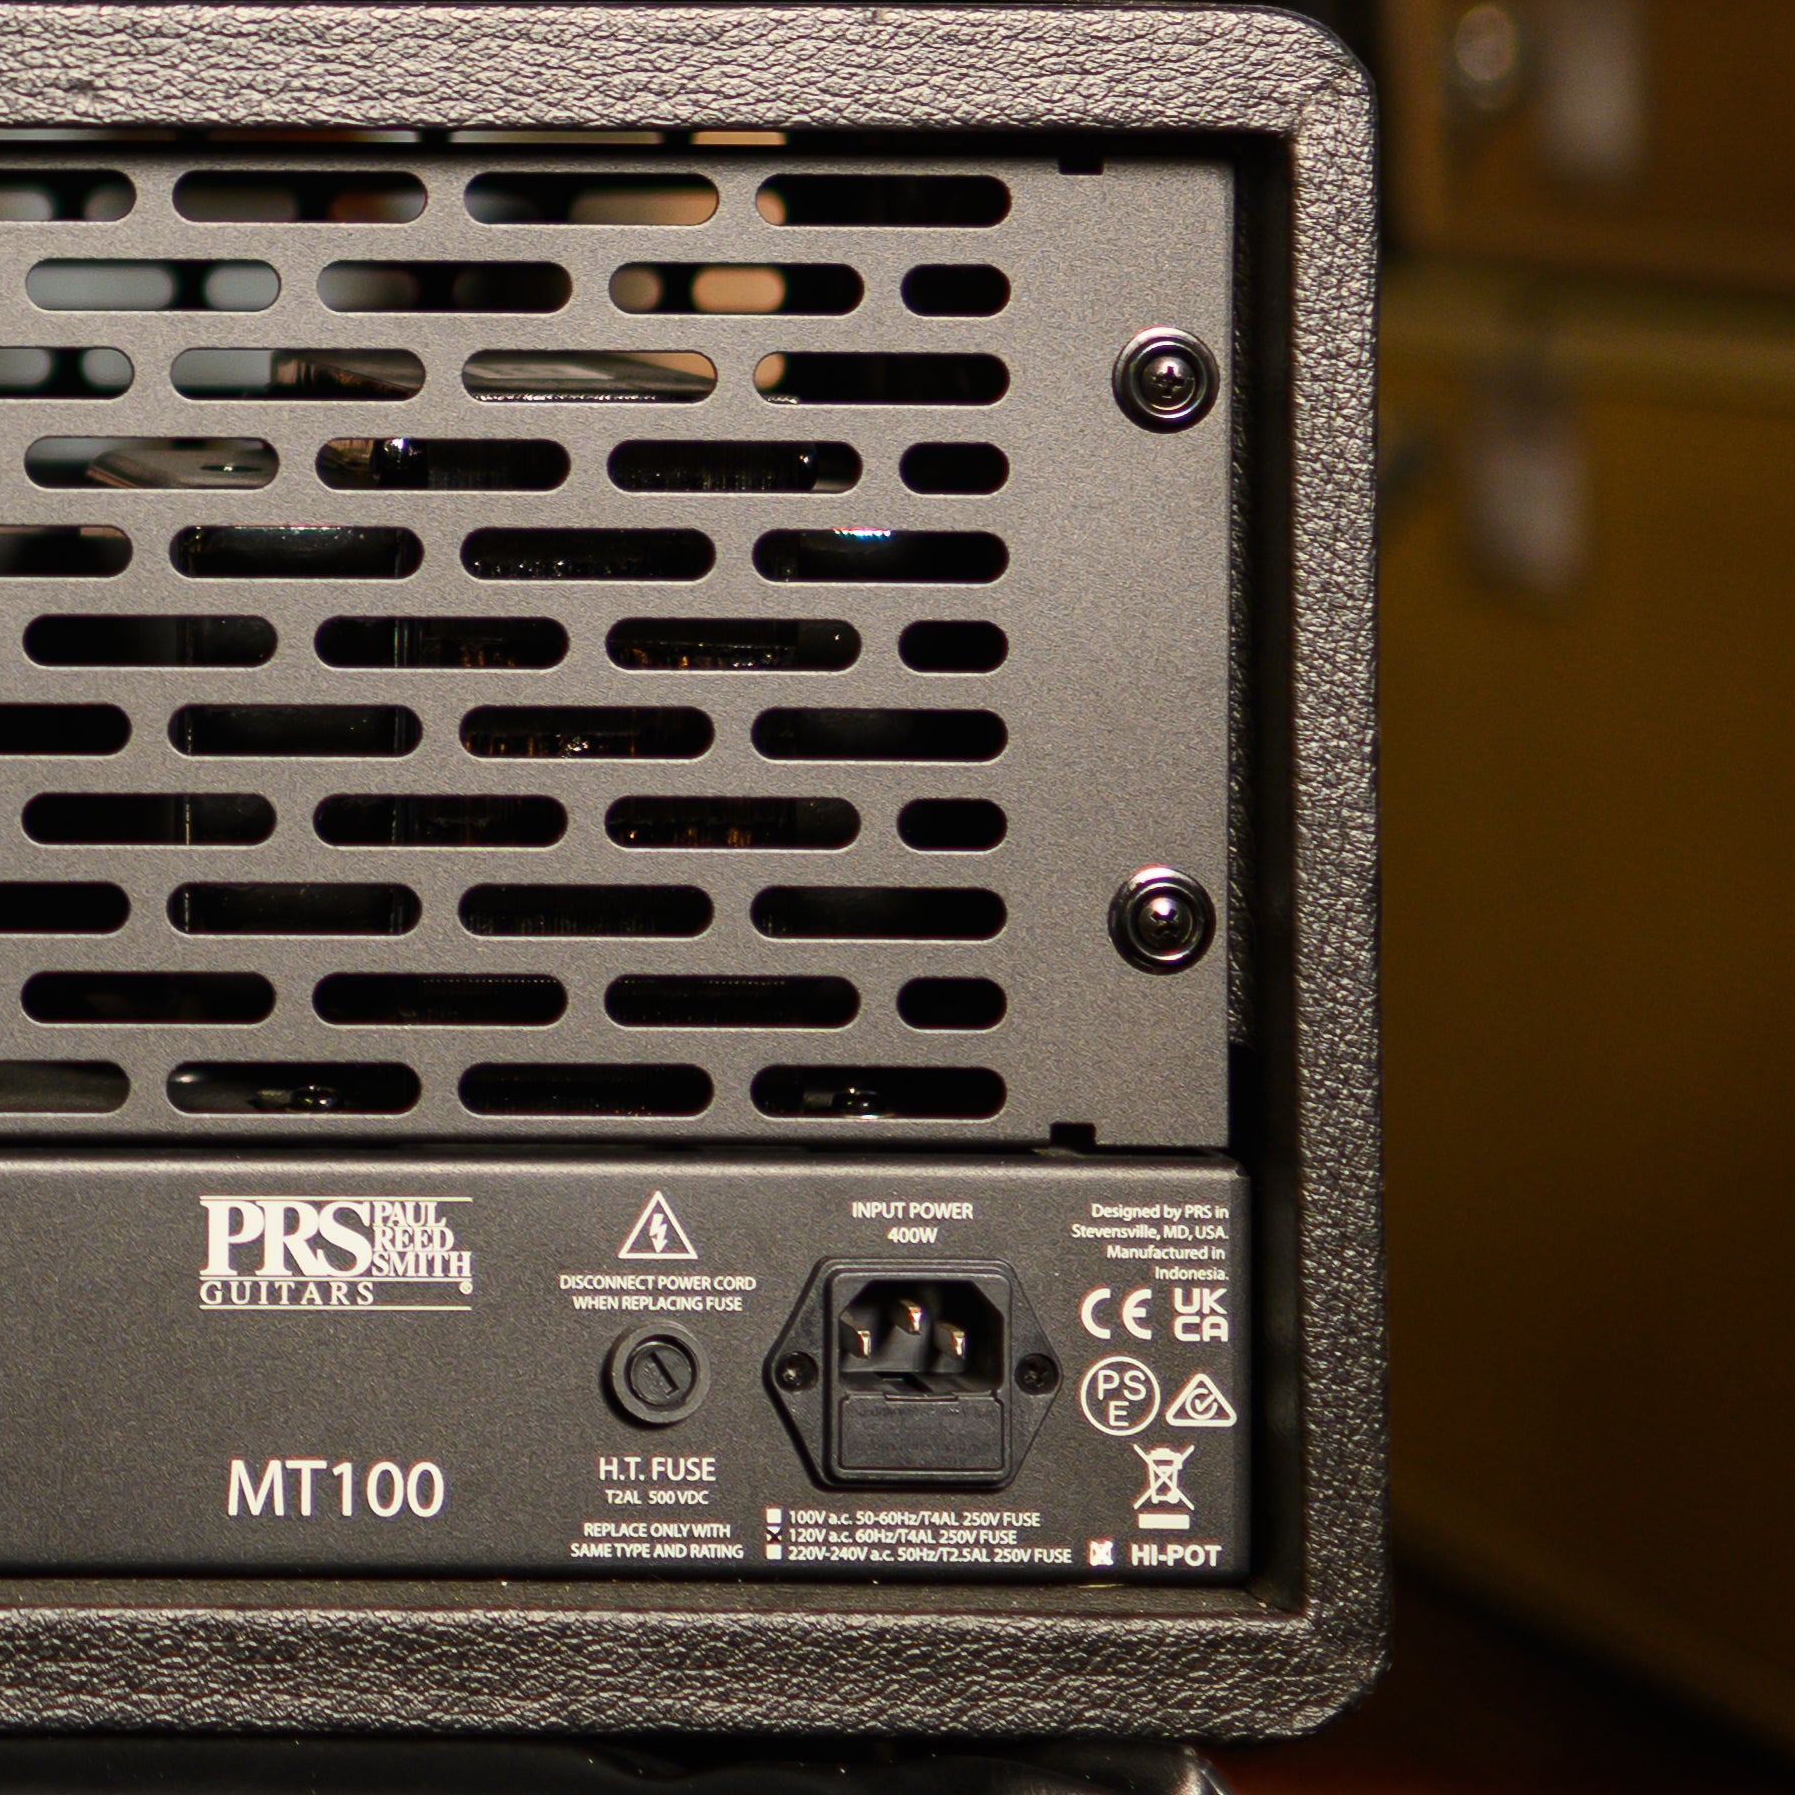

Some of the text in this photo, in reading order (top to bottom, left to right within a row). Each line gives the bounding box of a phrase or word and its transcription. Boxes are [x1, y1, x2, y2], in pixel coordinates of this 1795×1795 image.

[373, 1201, 446, 1227] PAUL
[852, 1201, 974, 1220] INPUT POWER
[1091, 1202, 1230, 1222] Designed by PRS in
[199, 1200, 373, 1277] PRS
[372, 1226, 455, 1252] REED
[887, 1226, 939, 1244] 400W
[1071, 1223, 1229, 1242] Stevensville, MD, USA.
[1106, 1244, 1226, 1260] Manufactured in
[372, 1251, 472, 1277] SMITH
[1154, 1265, 1230, 1281] Indonesia.
[199, 1280, 374, 1305] GUITARS
[559, 1274, 757, 1291] DISCONNECT POWER CORD
[571, 1295, 743, 1312] WHEN REPLACING FUSE
[1174, 1288, 1228, 1315] UK
[1174, 1316, 1229, 1342] CA
[599, 1456, 716, 1482] H.T. FUSE
[227, 1459, 445, 1518] MT100
[604, 1489, 709, 1505] T2AL 500 VDC
[789, 1509, 827, 1529] 100V
[827, 1512, 853, 1526] a.c.
[962, 1511, 1001, 1527] 250V
[1002, 1511, 1041, 1527] FUSE
[789, 1527, 827, 1547] 120V
[827, 1530, 853, 1547] a.c.
[938, 1529, 978, 1545] 250V
[979, 1529, 1018, 1545] FUSE
[1131, 1543, 1223, 1567] HI-POT
